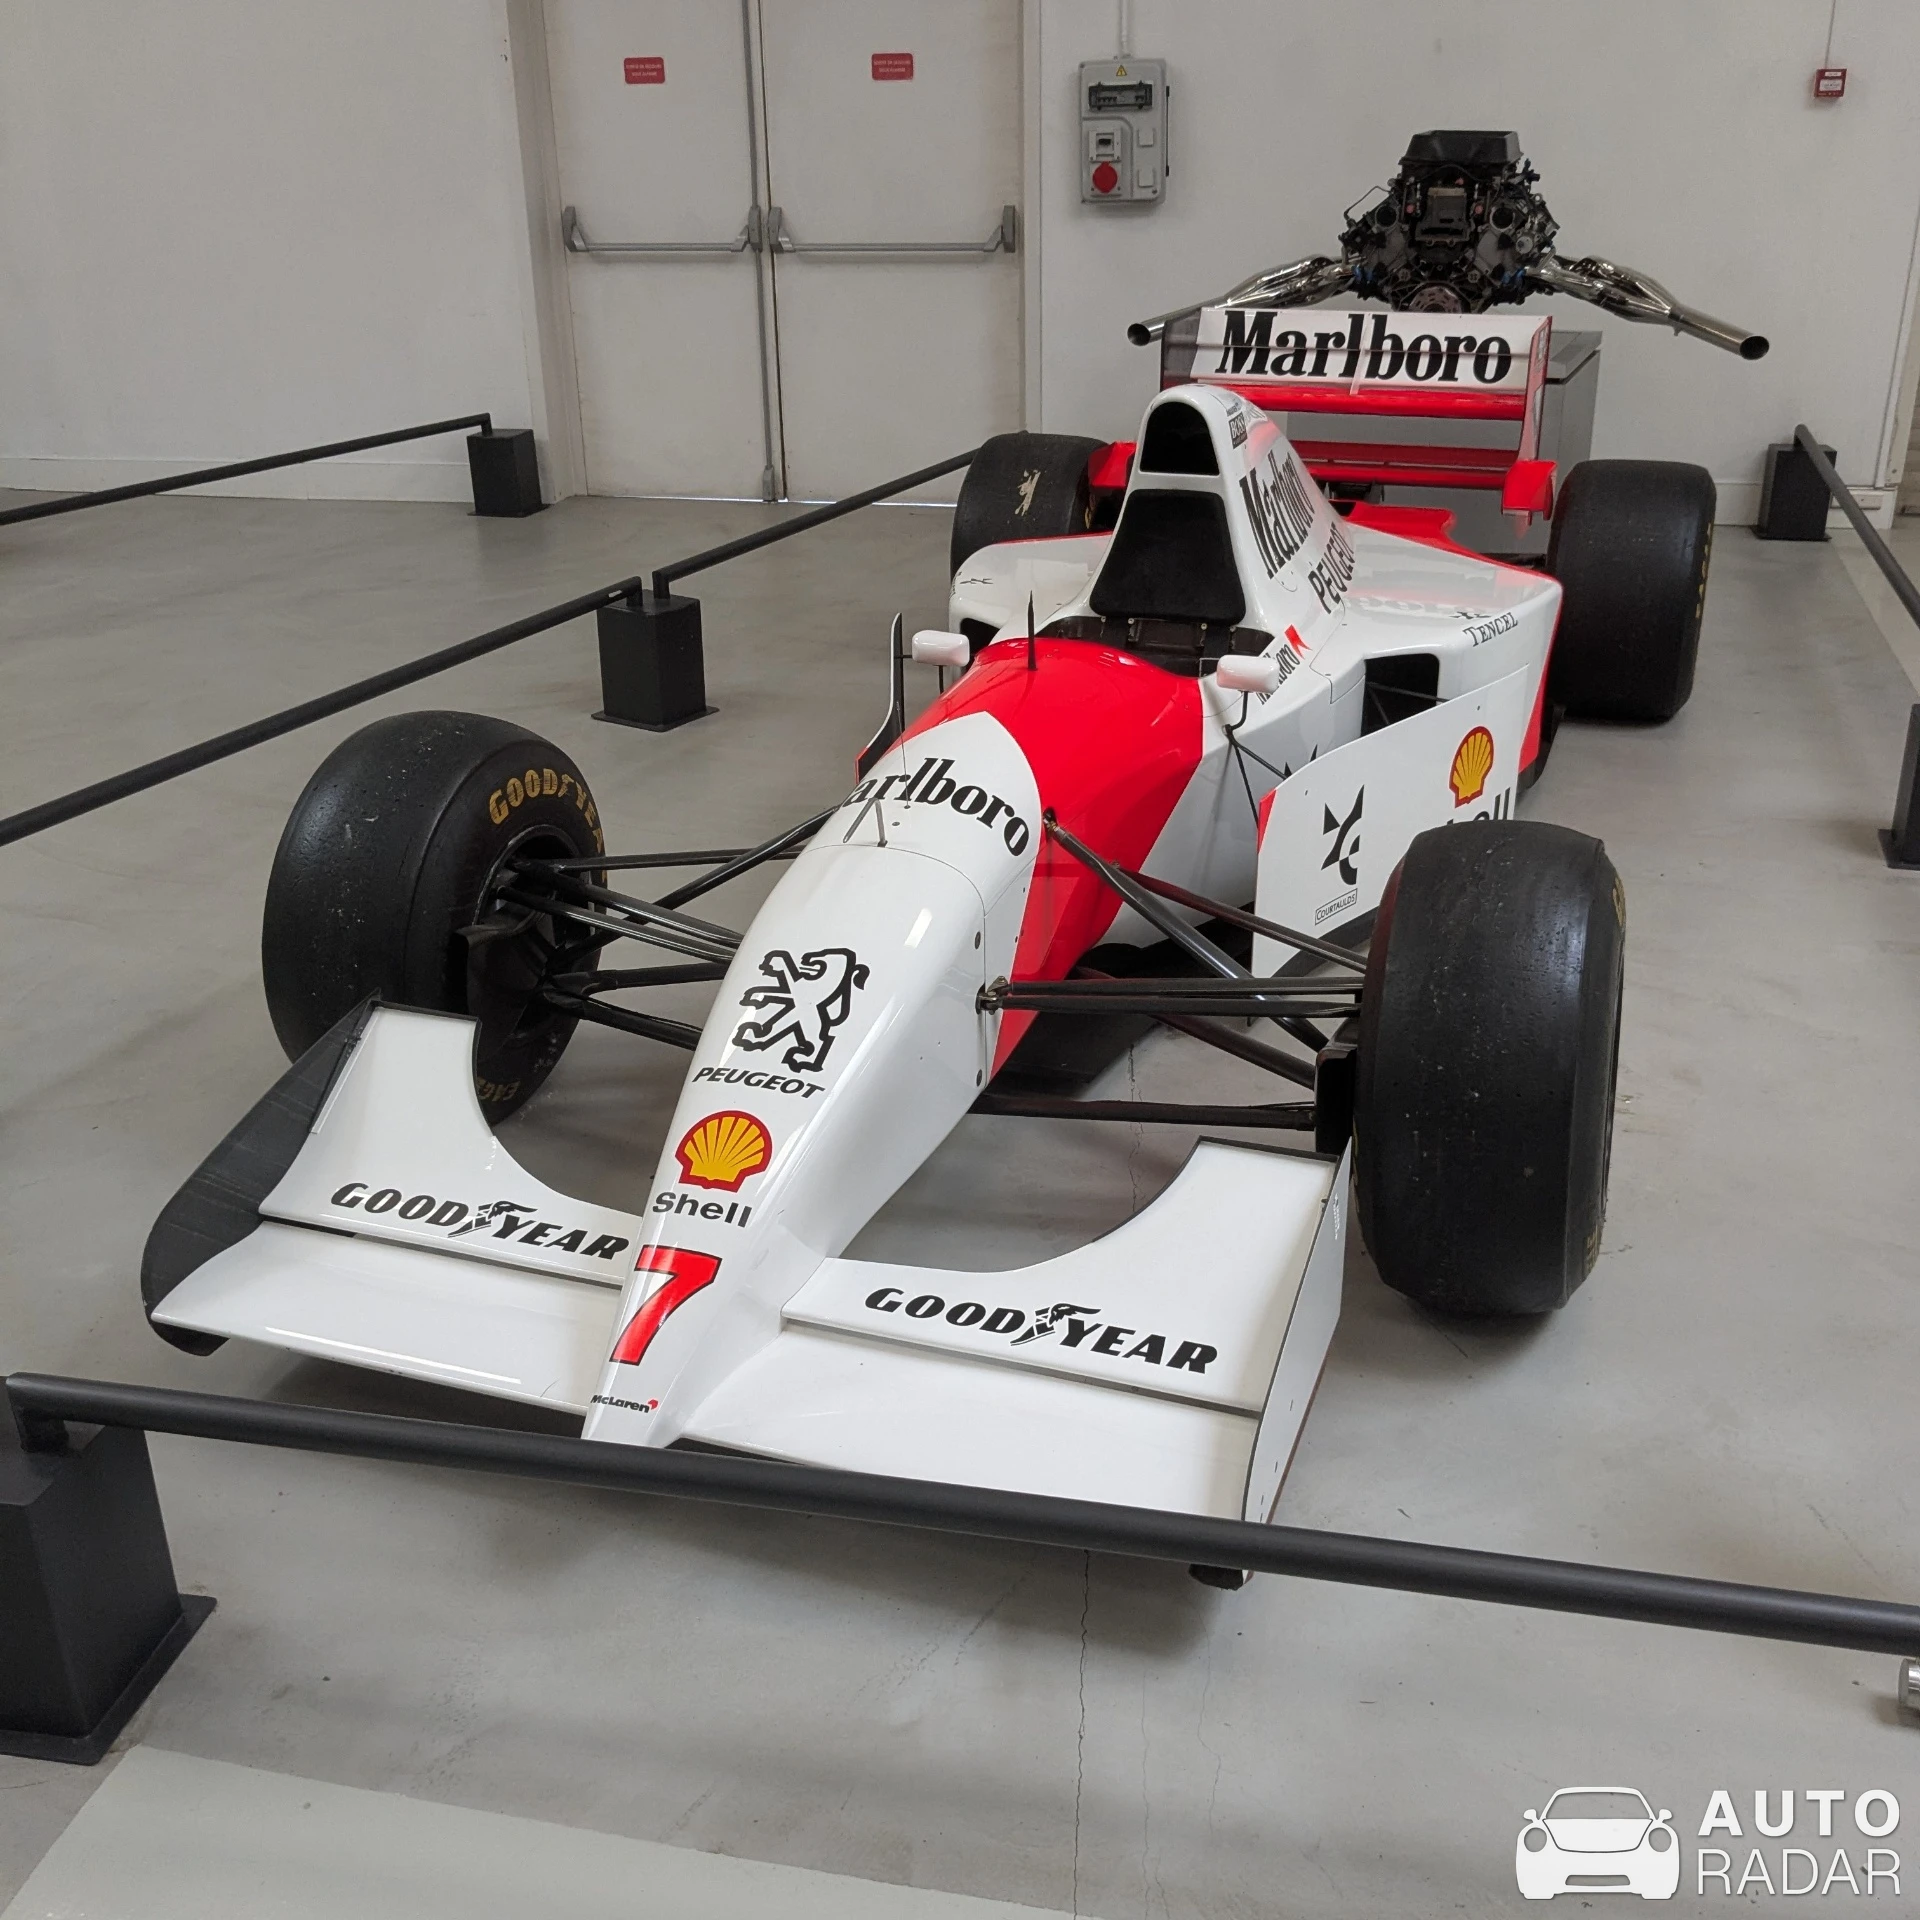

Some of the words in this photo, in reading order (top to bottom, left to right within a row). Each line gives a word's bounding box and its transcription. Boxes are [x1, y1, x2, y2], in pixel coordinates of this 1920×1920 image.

[1215, 310, 1511, 384] Marlboro
[1239, 449, 1315, 579] Marlboro
[1308, 521, 1355, 614] PEUGEOT
[1463, 612, 1519, 647] TENCEL
[842, 757, 1029, 856] arlboro
[692, 1066, 826, 1099] PEUGEOT
[652, 1191, 753, 1228] Shell
[609, 1244, 723, 1366] 7
[590, 1395, 650, 1413] McLaren
